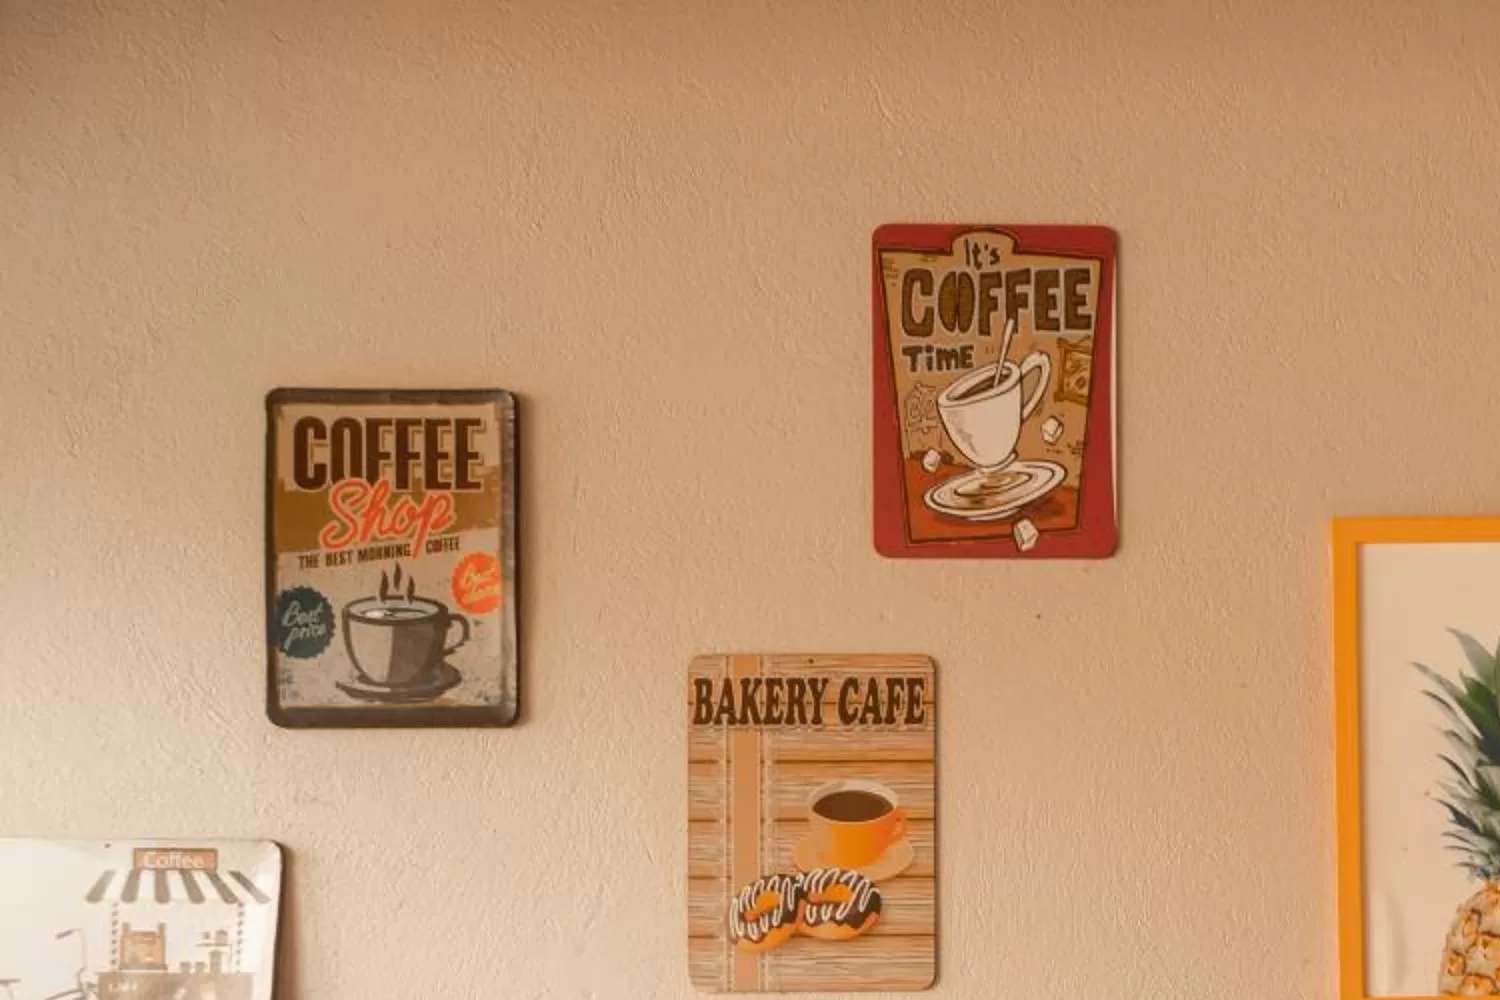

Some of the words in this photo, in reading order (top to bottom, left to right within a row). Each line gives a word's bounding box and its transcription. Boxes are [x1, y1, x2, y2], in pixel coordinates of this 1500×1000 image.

[963, 239, 1000, 270] It's
[901, 266, 1093, 337] COFFEE
[293, 415, 484, 491] COFFEE
[319, 477, 455, 560] Shop
[298, 554, 320, 569] THE
[325, 550, 353, 567] BEST
[357, 543, 412, 563] MORNING
[692, 676, 829, 726] BAKERY
[837, 676, 926, 726] CAFE
[141, 851, 205, 869] Coffee
